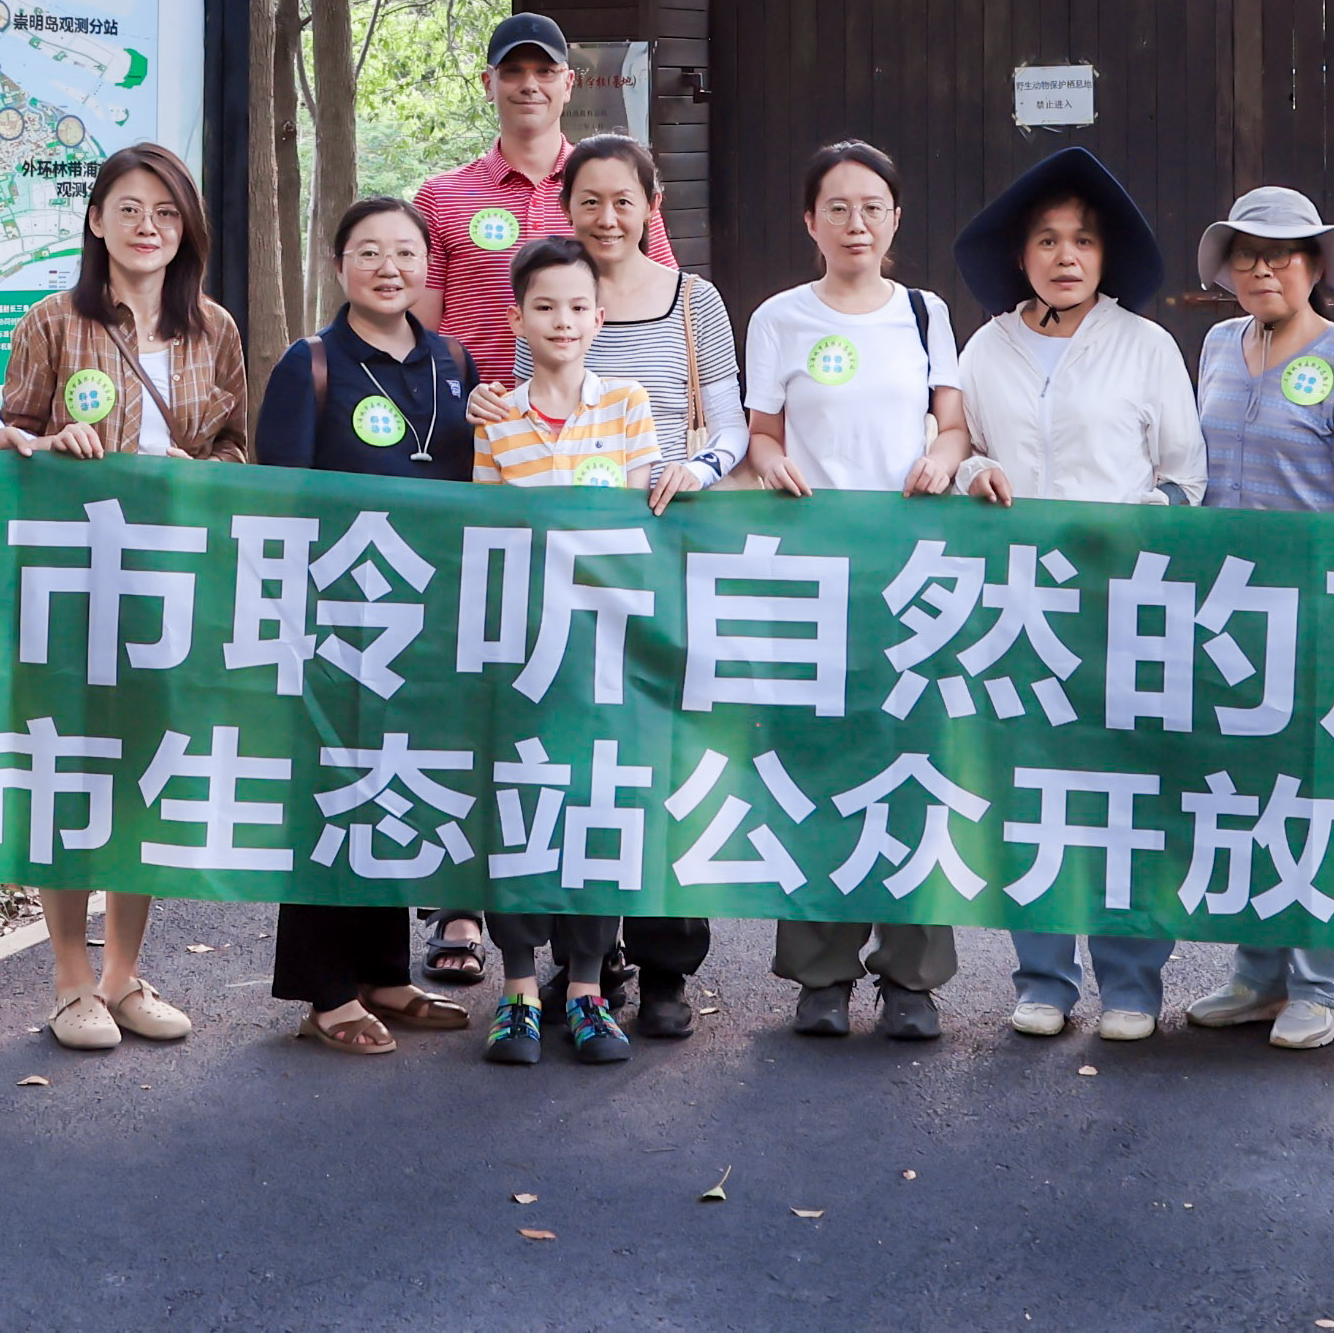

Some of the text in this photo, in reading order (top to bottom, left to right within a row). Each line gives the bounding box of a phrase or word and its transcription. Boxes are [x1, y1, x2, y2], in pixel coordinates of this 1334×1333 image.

[13, 12, 118, 36] 崇明岛观测分站
[22, 155, 101, 178] 外环林带浦
